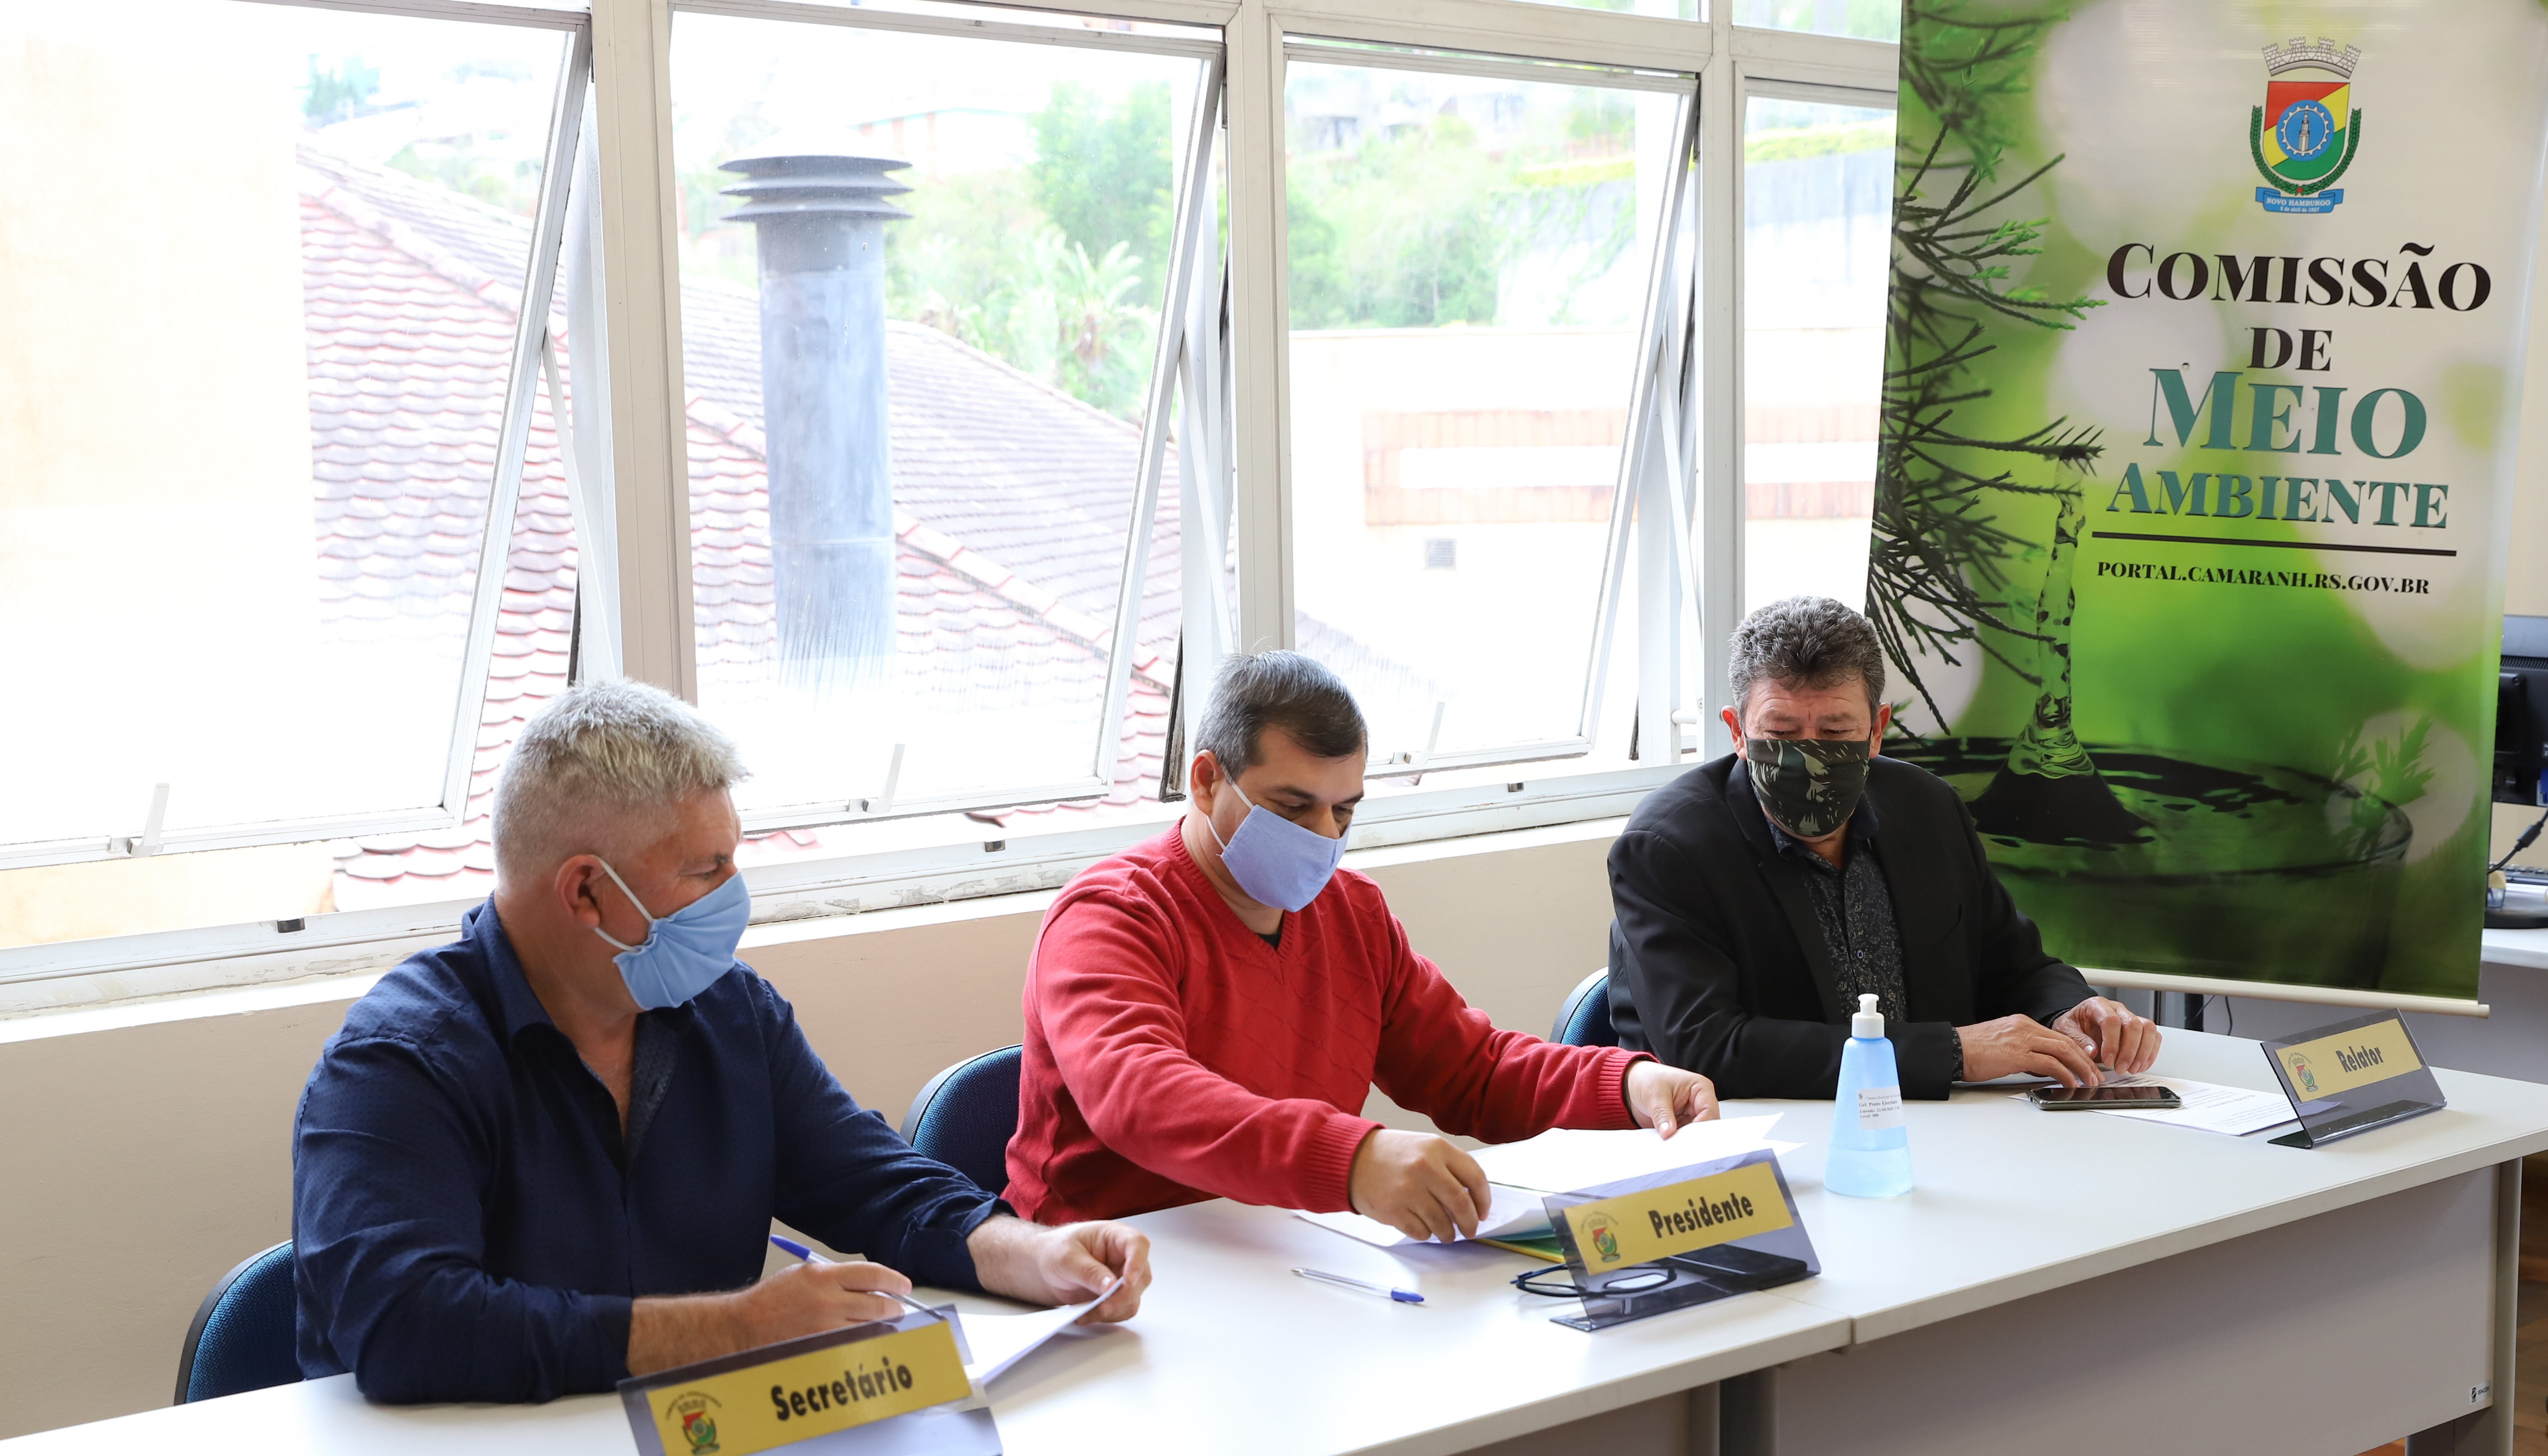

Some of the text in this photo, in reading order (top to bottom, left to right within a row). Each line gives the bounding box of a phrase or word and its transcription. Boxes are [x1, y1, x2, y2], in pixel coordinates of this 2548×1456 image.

[2266, 197, 2287, 206] NOVO
[2107, 242, 2491, 311] COMISSÃO
[2247, 328, 2332, 371] DE
[2143, 368, 2427, 459] MEIO
[2106, 462, 2449, 528] AMBIENTE
[2097, 561, 2430, 594] PORTAL.CAMARANH.RS.GOV.BR
[2335, 1045, 2384, 1072] Relator
[1647, 1193, 1754, 1238] Presidente
[771, 1356, 913, 1421] Secretário
